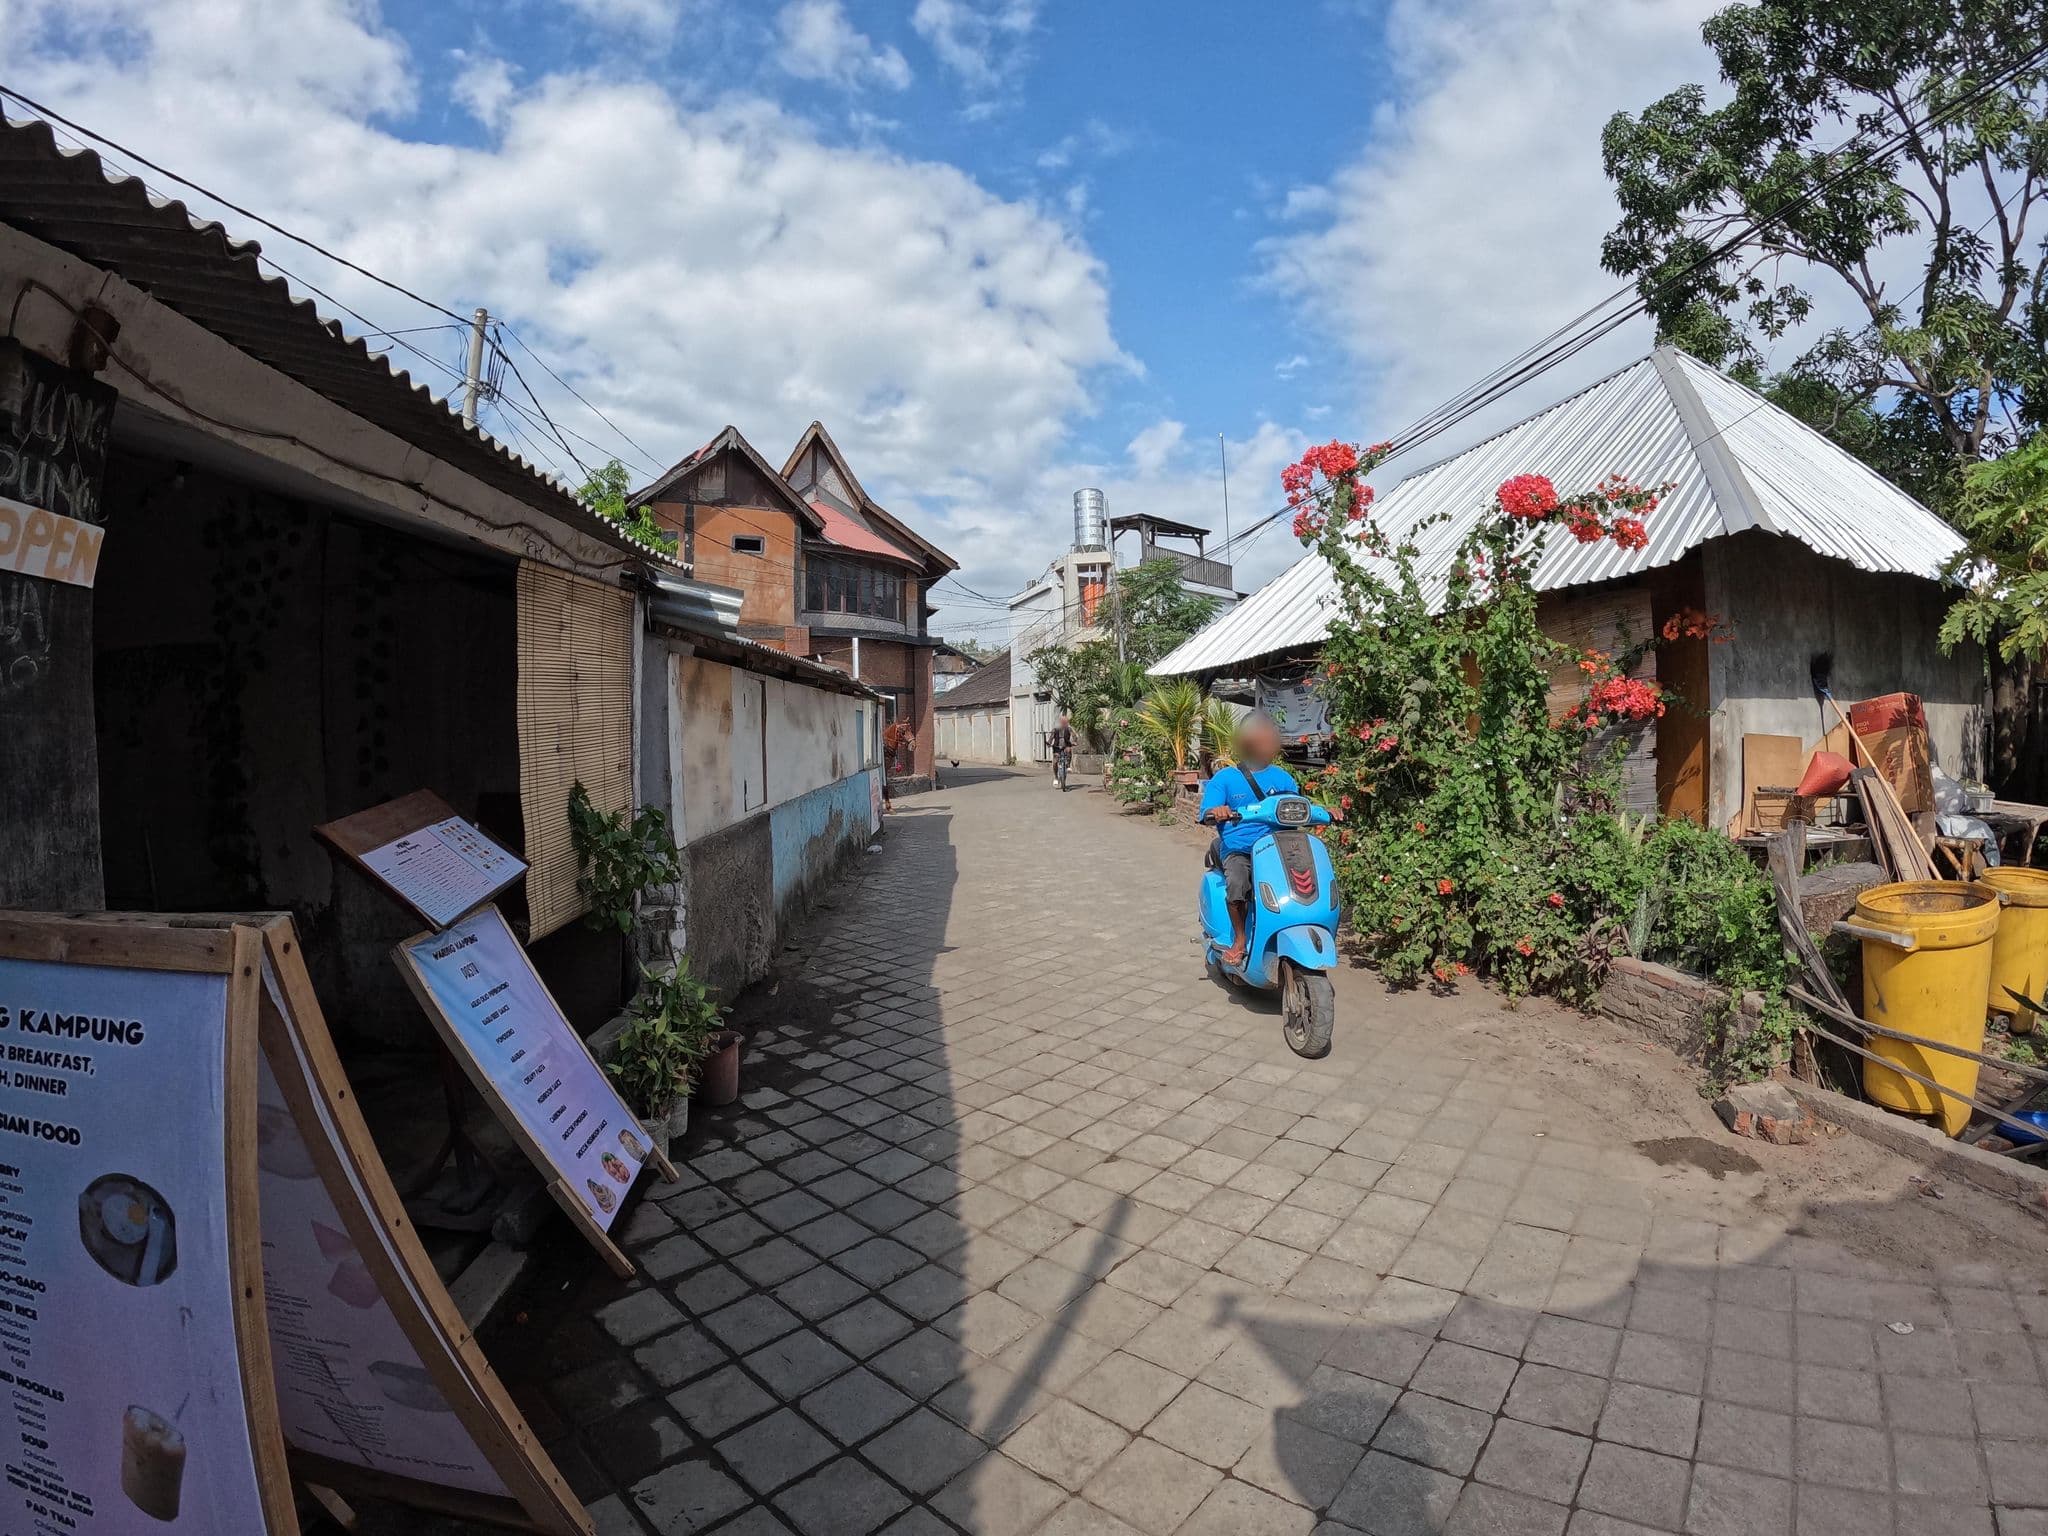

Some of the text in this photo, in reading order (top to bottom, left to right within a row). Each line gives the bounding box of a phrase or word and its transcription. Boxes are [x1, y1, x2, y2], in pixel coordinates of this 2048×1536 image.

[20, 1009, 144, 1045] KAMPUNG
[8, 1045, 95, 1075] BREAKFAST,
[14, 1072, 67, 1096] DINNER
[32, 1120, 81, 1146] FOOD
[12, 1390, 44, 1408] Chicken
[15, 1375, 65, 1402] NOODLES
[21, 1432, 49, 1450] SOUP
[23, 1448, 57, 1468] Chicken
[26, 1499, 76, 1529] PAD THAI
